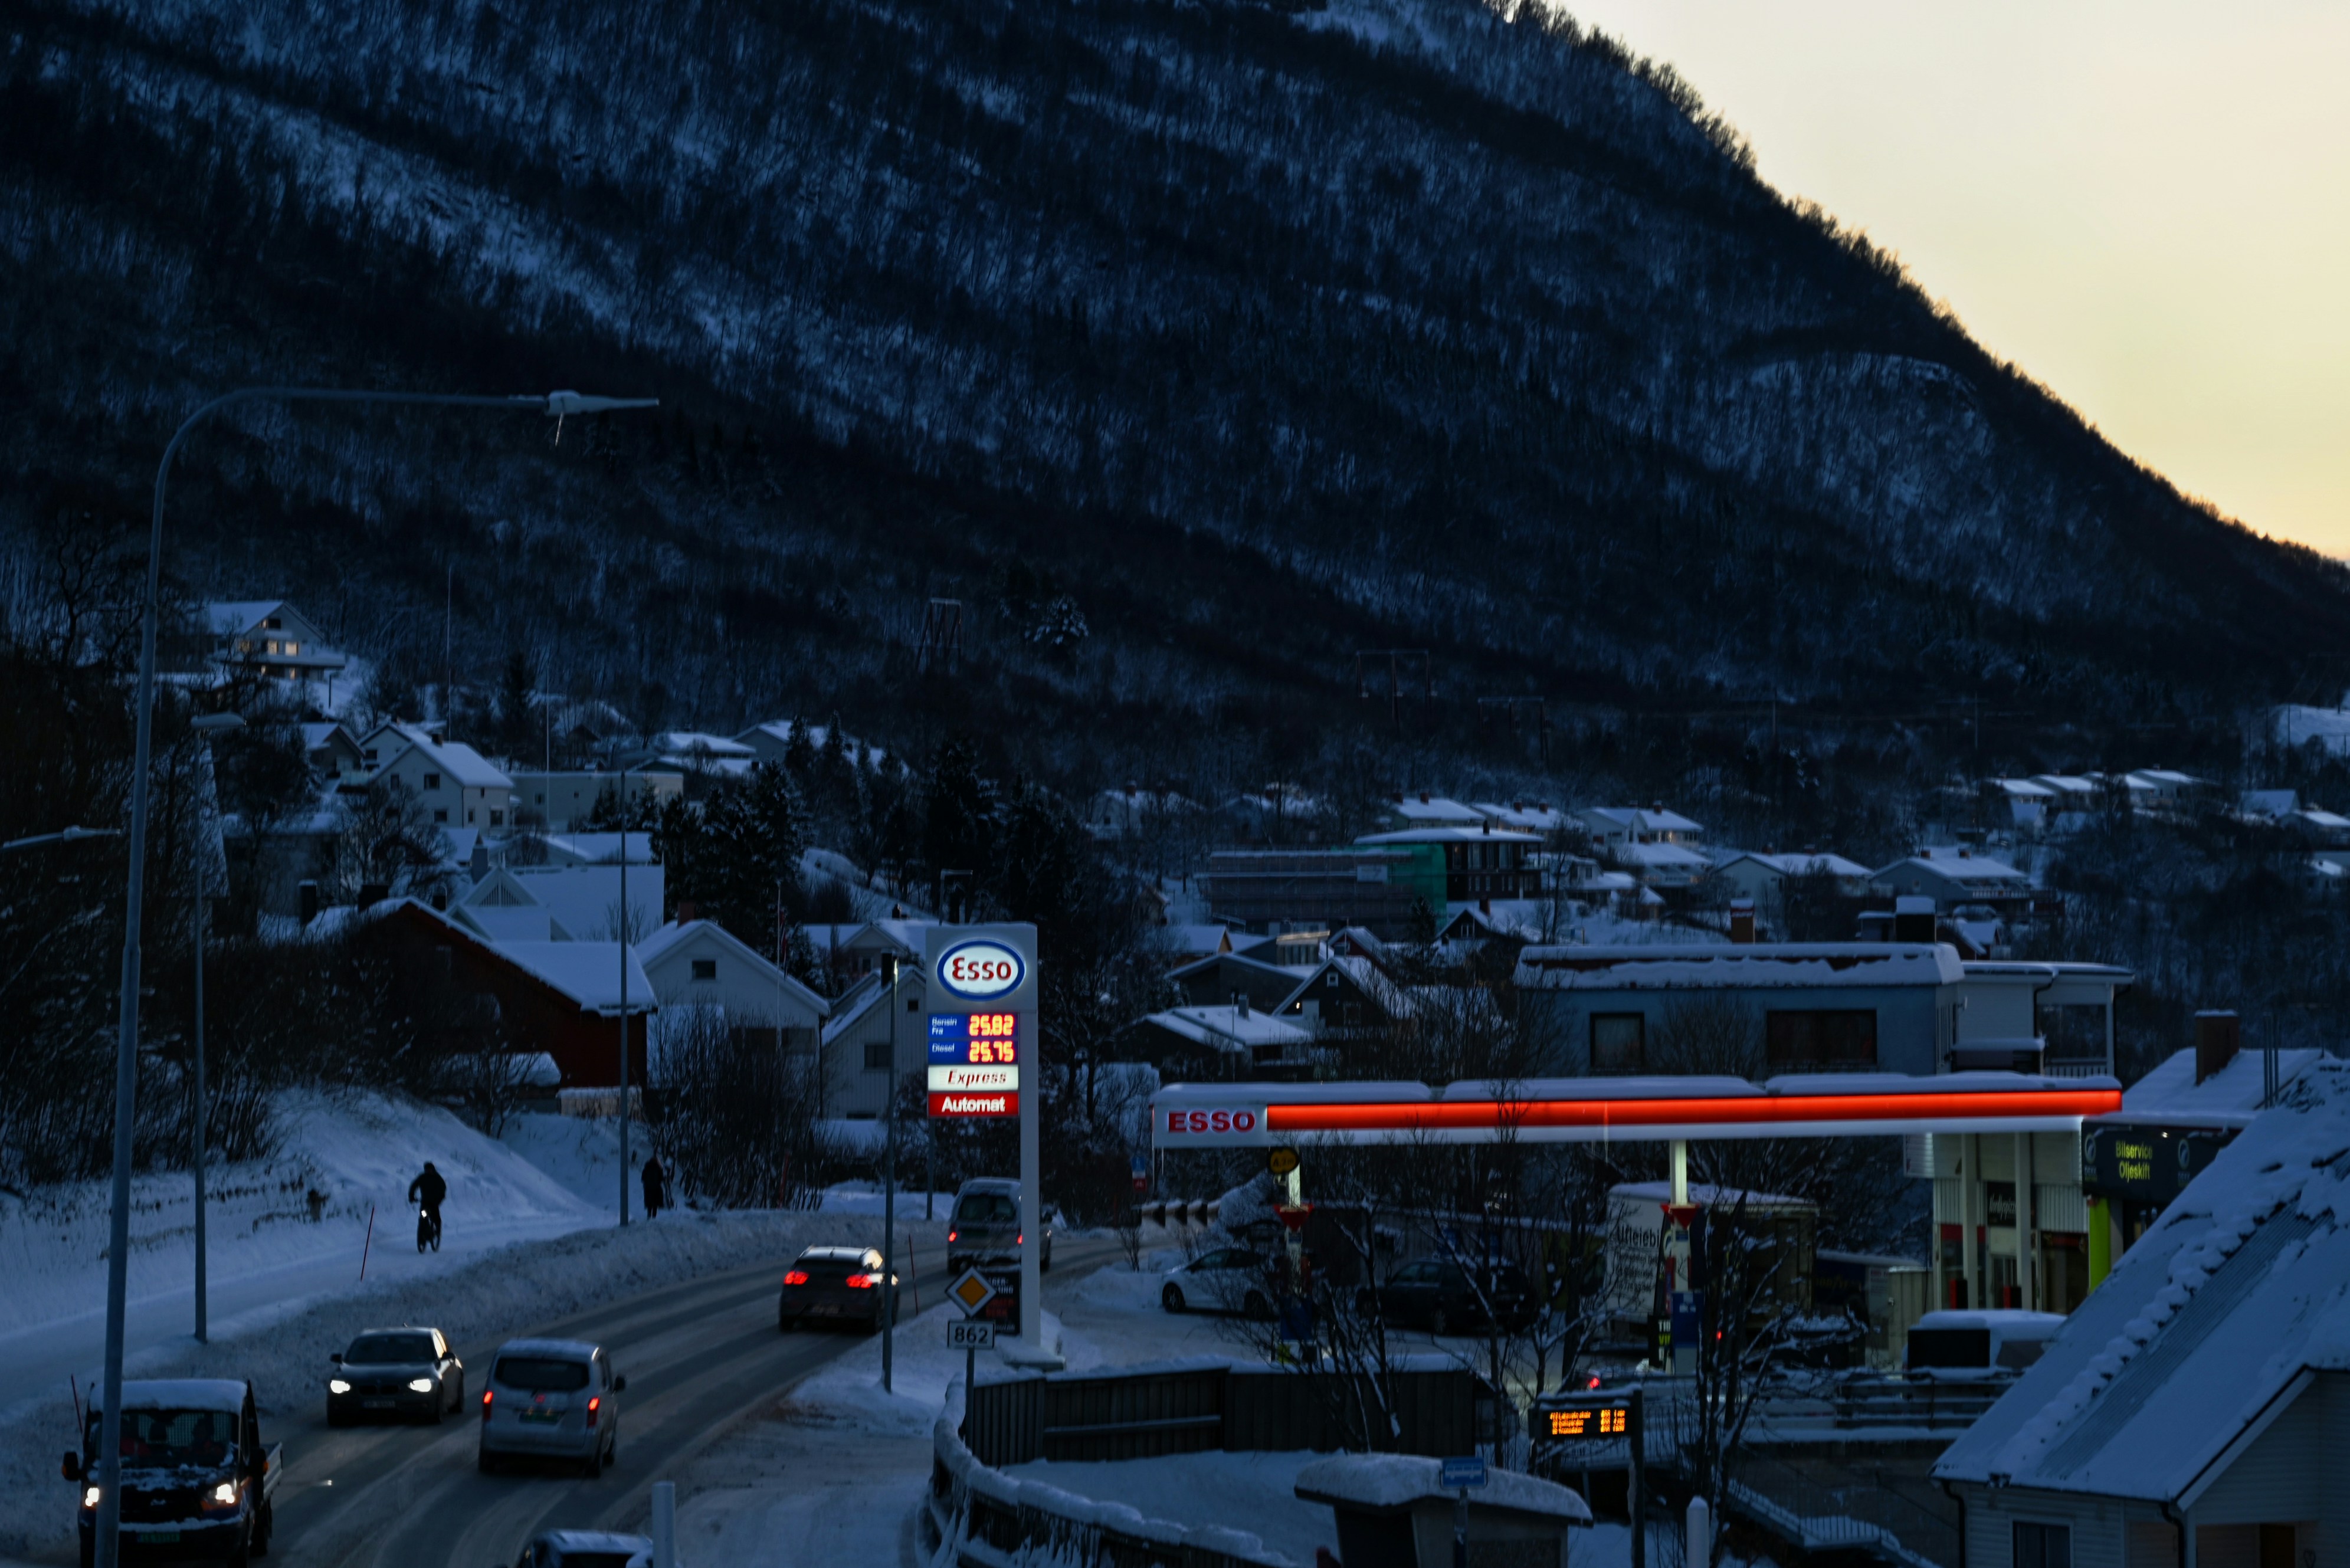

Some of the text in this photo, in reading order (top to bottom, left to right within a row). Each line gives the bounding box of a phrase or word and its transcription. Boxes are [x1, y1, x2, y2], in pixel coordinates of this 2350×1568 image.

[932, 1017, 957, 1026] Bensin
[932, 1026, 943, 1035] Fra
[932, 1043, 955, 1053] Diesel
[947, 1068, 1007, 1088] Express
[942, 1096, 1005, 1113] Automat
[1168, 1111, 1256, 1133] ESSO
[2115, 1140, 2153, 1160] Bilservice
[2119, 1160, 2151, 1183] Oljeskift
[1989, 1193, 2017, 1221] Nordlyspizz
[954, 1325, 988, 1344] 862
